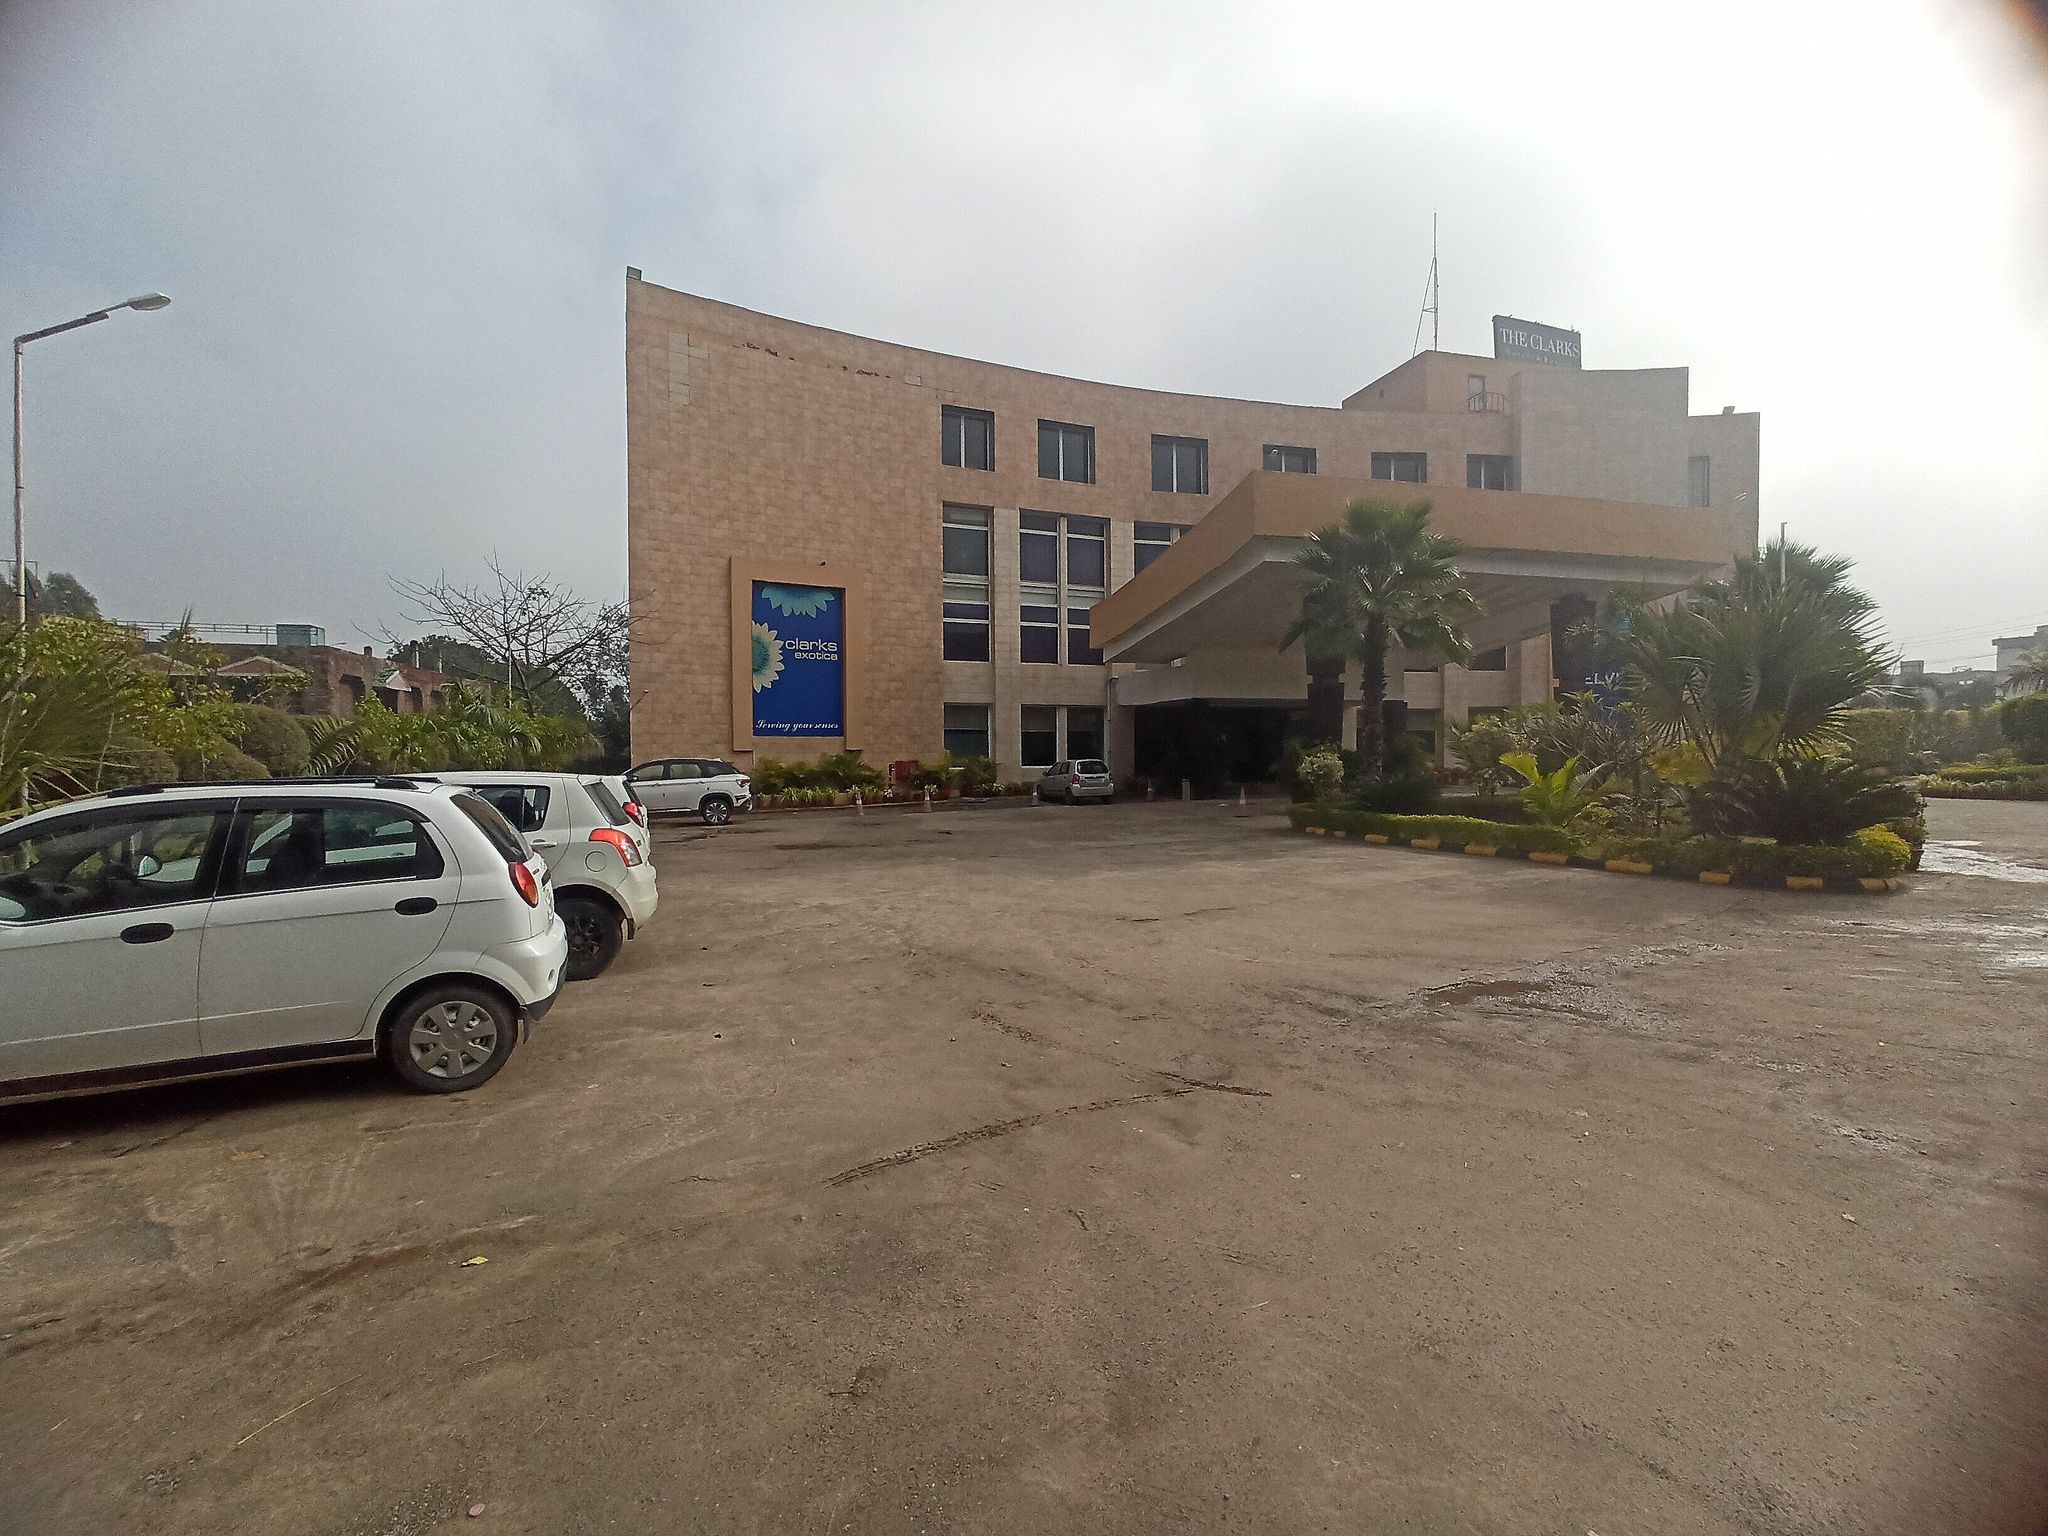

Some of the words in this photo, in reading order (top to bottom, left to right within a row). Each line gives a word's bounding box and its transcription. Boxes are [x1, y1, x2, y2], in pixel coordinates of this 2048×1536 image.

[1500, 328, 1528, 347] THE
[1530, 334, 1580, 358] CLARKS
[785, 637, 838, 652] clarks
[794, 651, 838, 661] exotica
